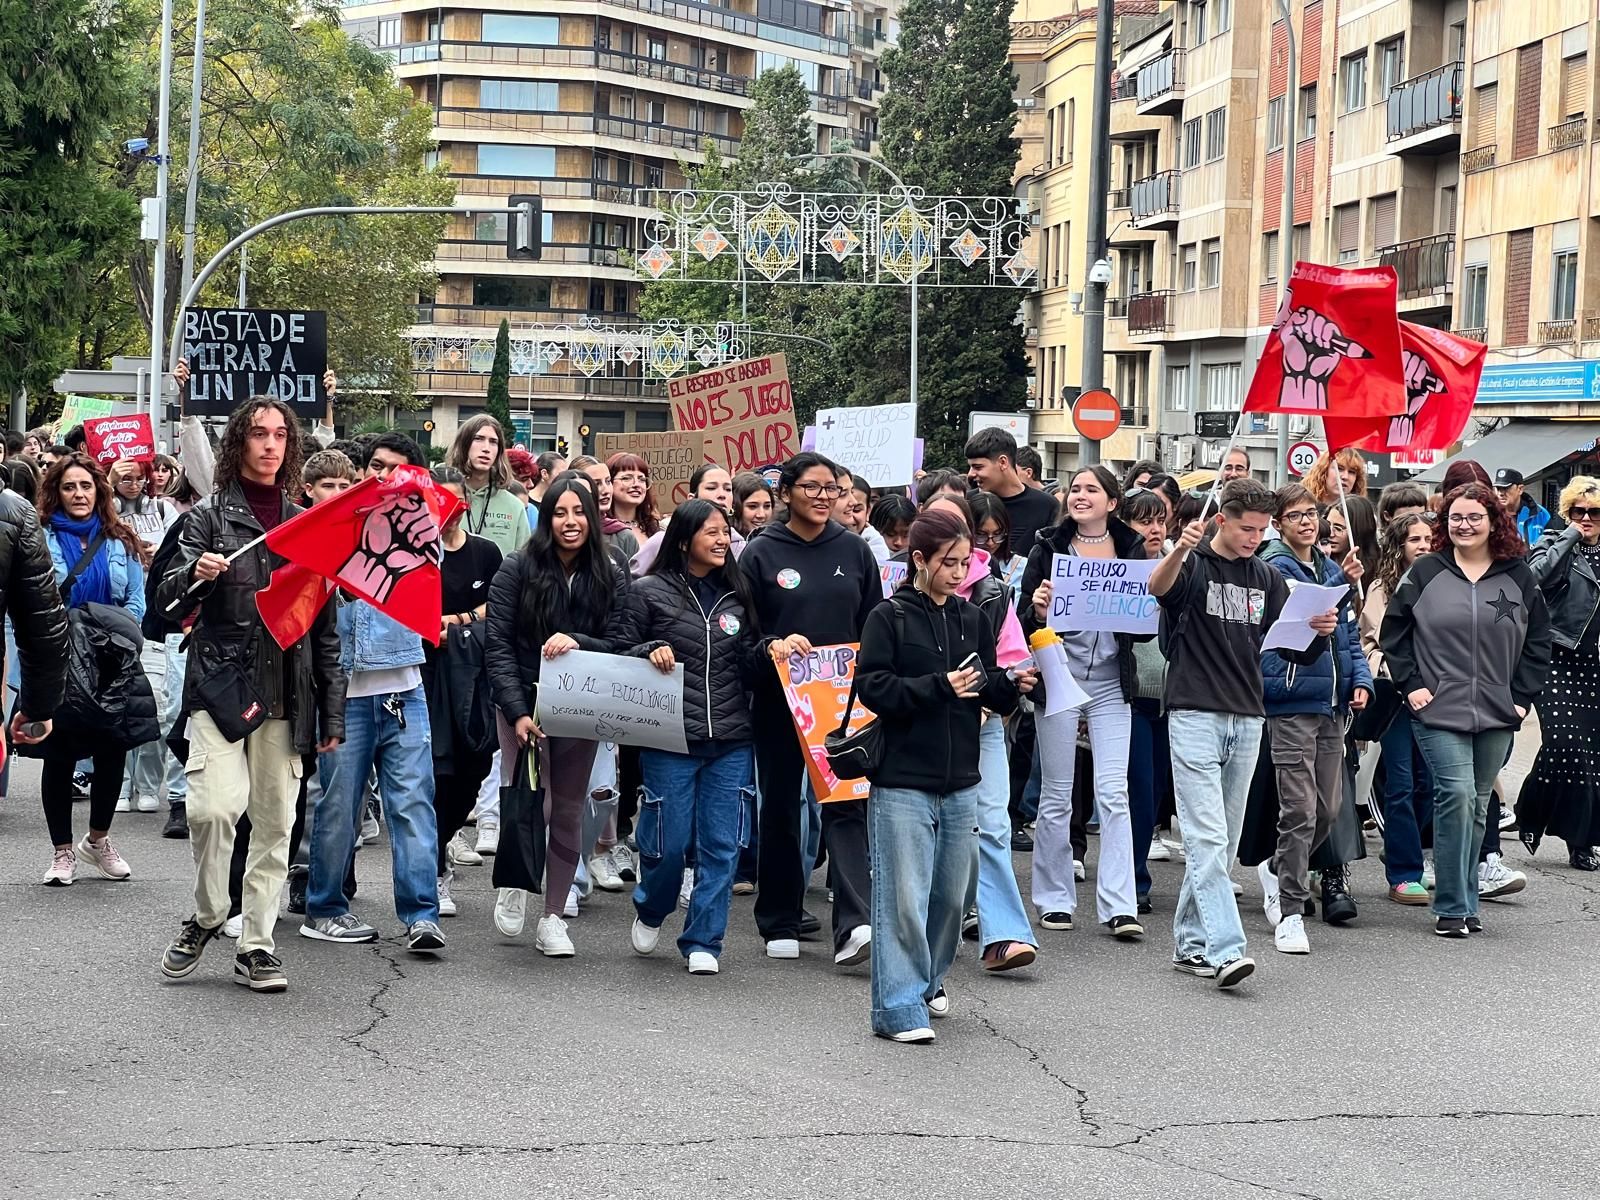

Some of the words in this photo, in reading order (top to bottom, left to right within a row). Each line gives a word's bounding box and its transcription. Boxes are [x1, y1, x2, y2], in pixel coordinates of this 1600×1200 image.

[185, 310, 266, 341] BASTA
[270, 313, 305, 343] DE
[184, 342, 273, 371] MIRAR
[280, 343, 297, 372] A
[190, 373, 234, 400] UN
[248, 372, 316, 402] LADO
[669, 382, 685, 397] EL
[725, 367, 738, 384] SE
[676, 397, 708, 431] NO
[707, 389, 734, 426] ES
[837, 405, 910, 429] RECURSOS
[605, 436, 624, 450] EL
[629, 433, 689, 449] BULLYING
[723, 422, 796, 476] DOLOR
[820, 436, 835, 451] LA
[844, 428, 892, 449] SALUD
[652, 448, 693, 465] JUEGO
[832, 450, 881, 463] MENTAL
[1295, 454, 1314, 465] 30
[1056, 558, 1075, 578] EL
[1079, 561, 1127, 578] ABUSO
[1080, 580, 1100, 591] SE
[1102, 580, 1148, 596] ALIMEN
[1054, 595, 1075, 617] DE
[1085, 595, 1157, 618] SILENCIO
[558, 673, 574, 691] NO
[581, 675, 599, 695] AL
[552, 705, 594, 716] DESCANSA
[600, 712, 614, 720] EN
[635, 717, 661, 727] SANDRA
